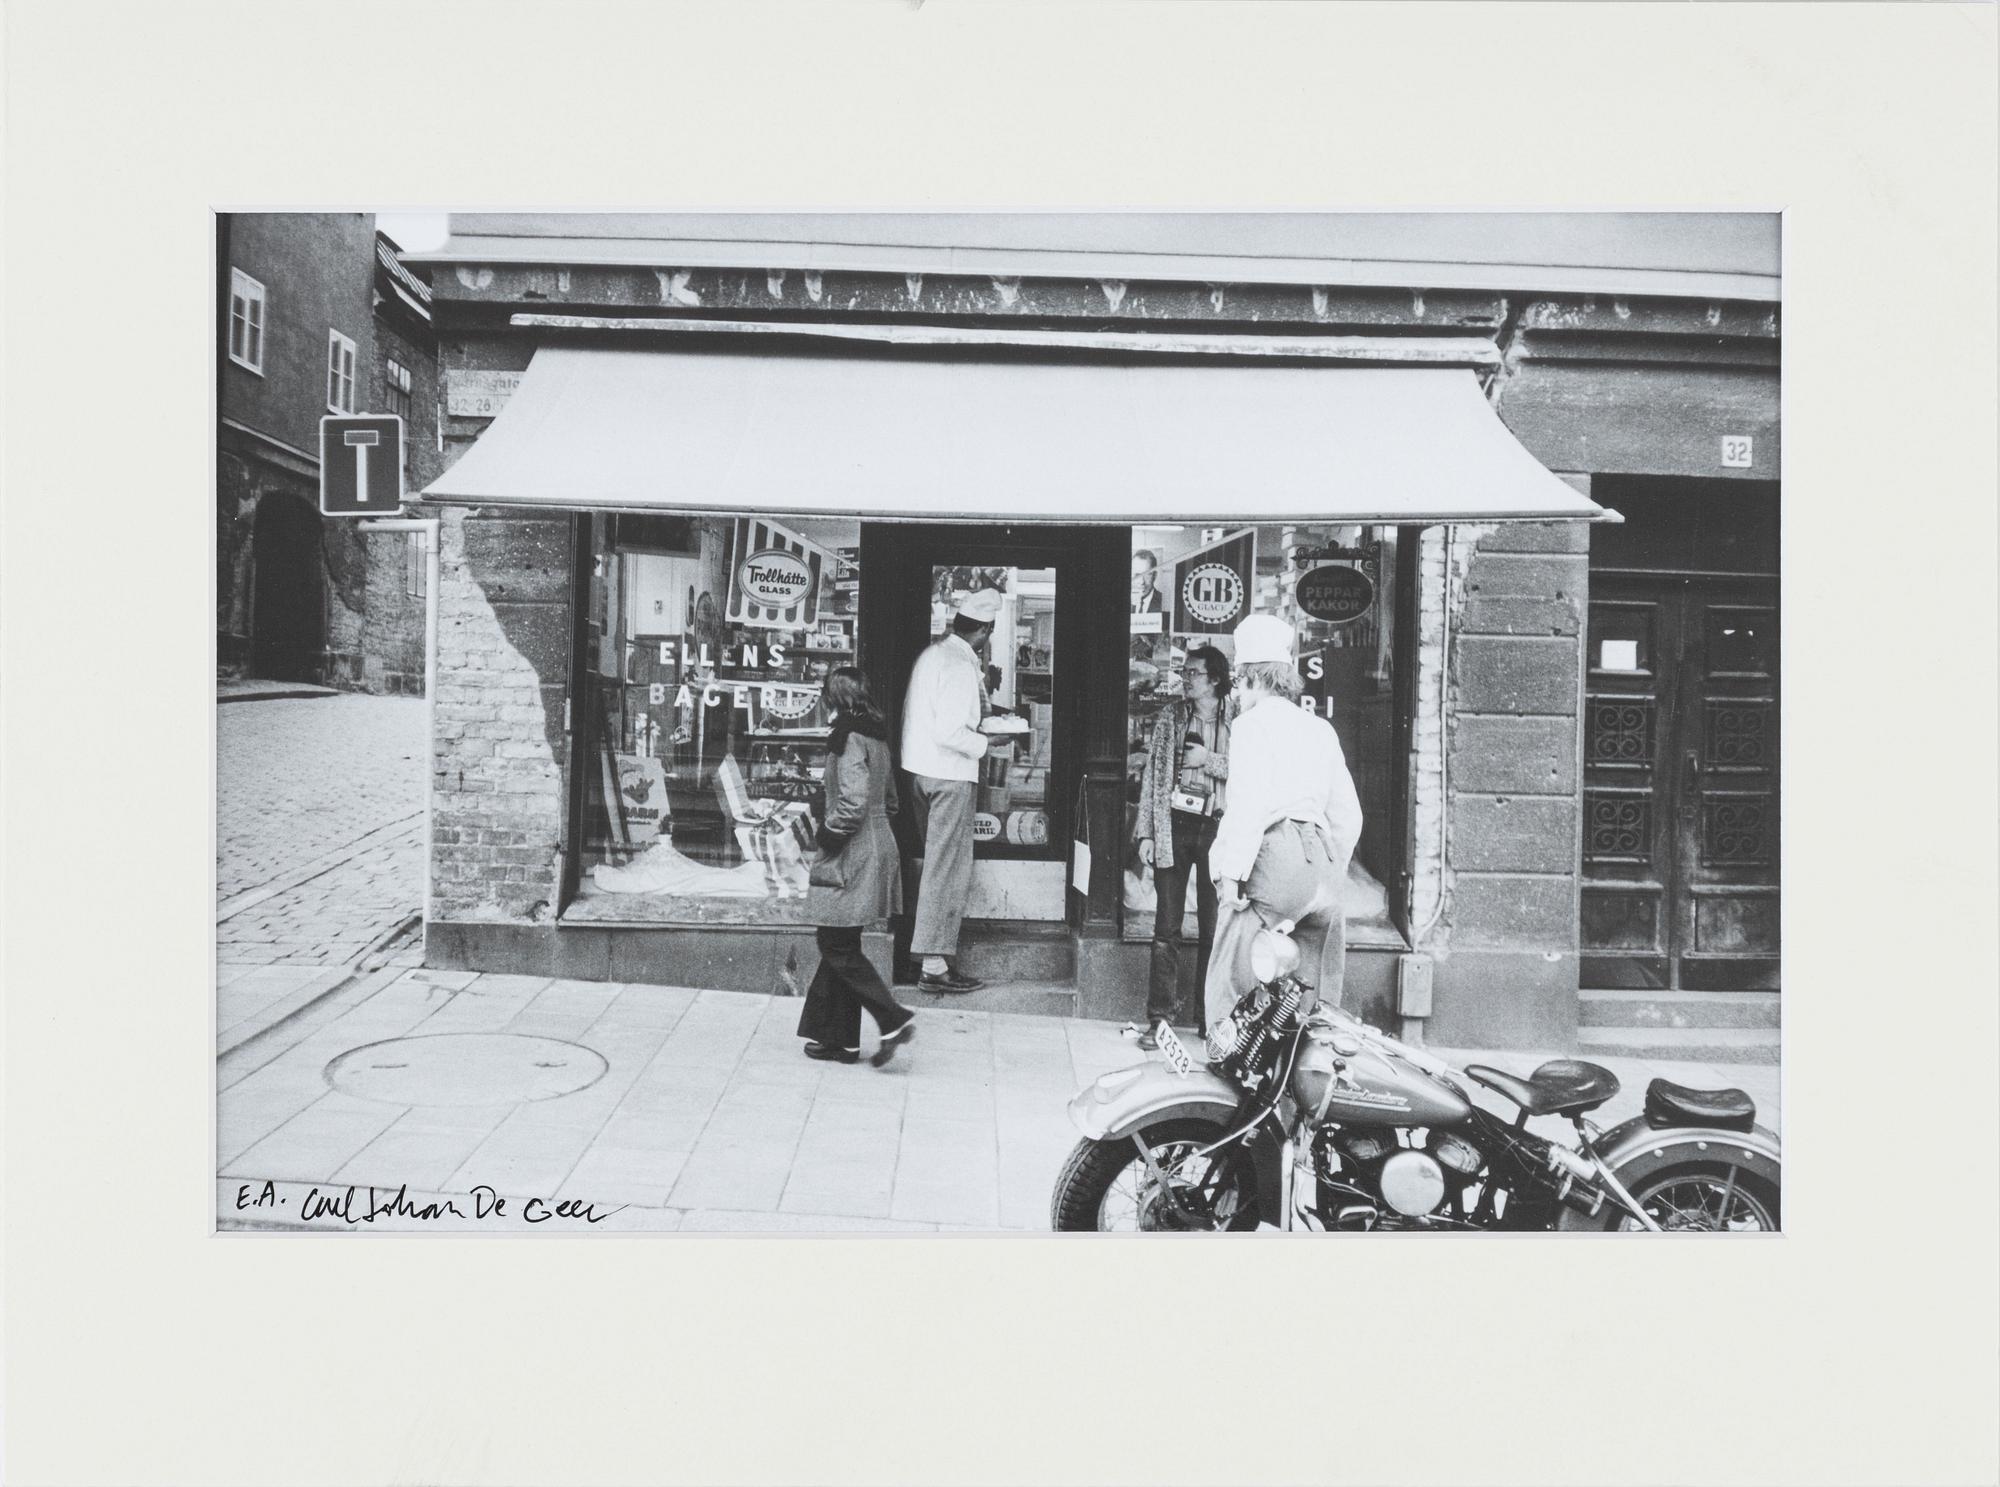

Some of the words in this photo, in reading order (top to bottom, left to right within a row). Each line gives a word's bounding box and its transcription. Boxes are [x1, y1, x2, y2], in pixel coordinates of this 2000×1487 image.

[1727, 442, 1748, 461] 32
[748, 565, 807, 586] Trollhätte
[758, 586, 791, 595] GLASS
[1193, 577, 1233, 603] GB
[1304, 586, 1361, 598] PEPPAR
[1306, 600, 1361, 611] KAKOR
[659, 641, 785, 667] ELLENS
[649, 683, 794, 709] BAGERI
[973, 827, 996, 835] ARIE
[1159, 1027, 1189, 1073] A2528
[236, 1180, 286, 1210] E.A.
[469, 1185, 507, 1219] De
